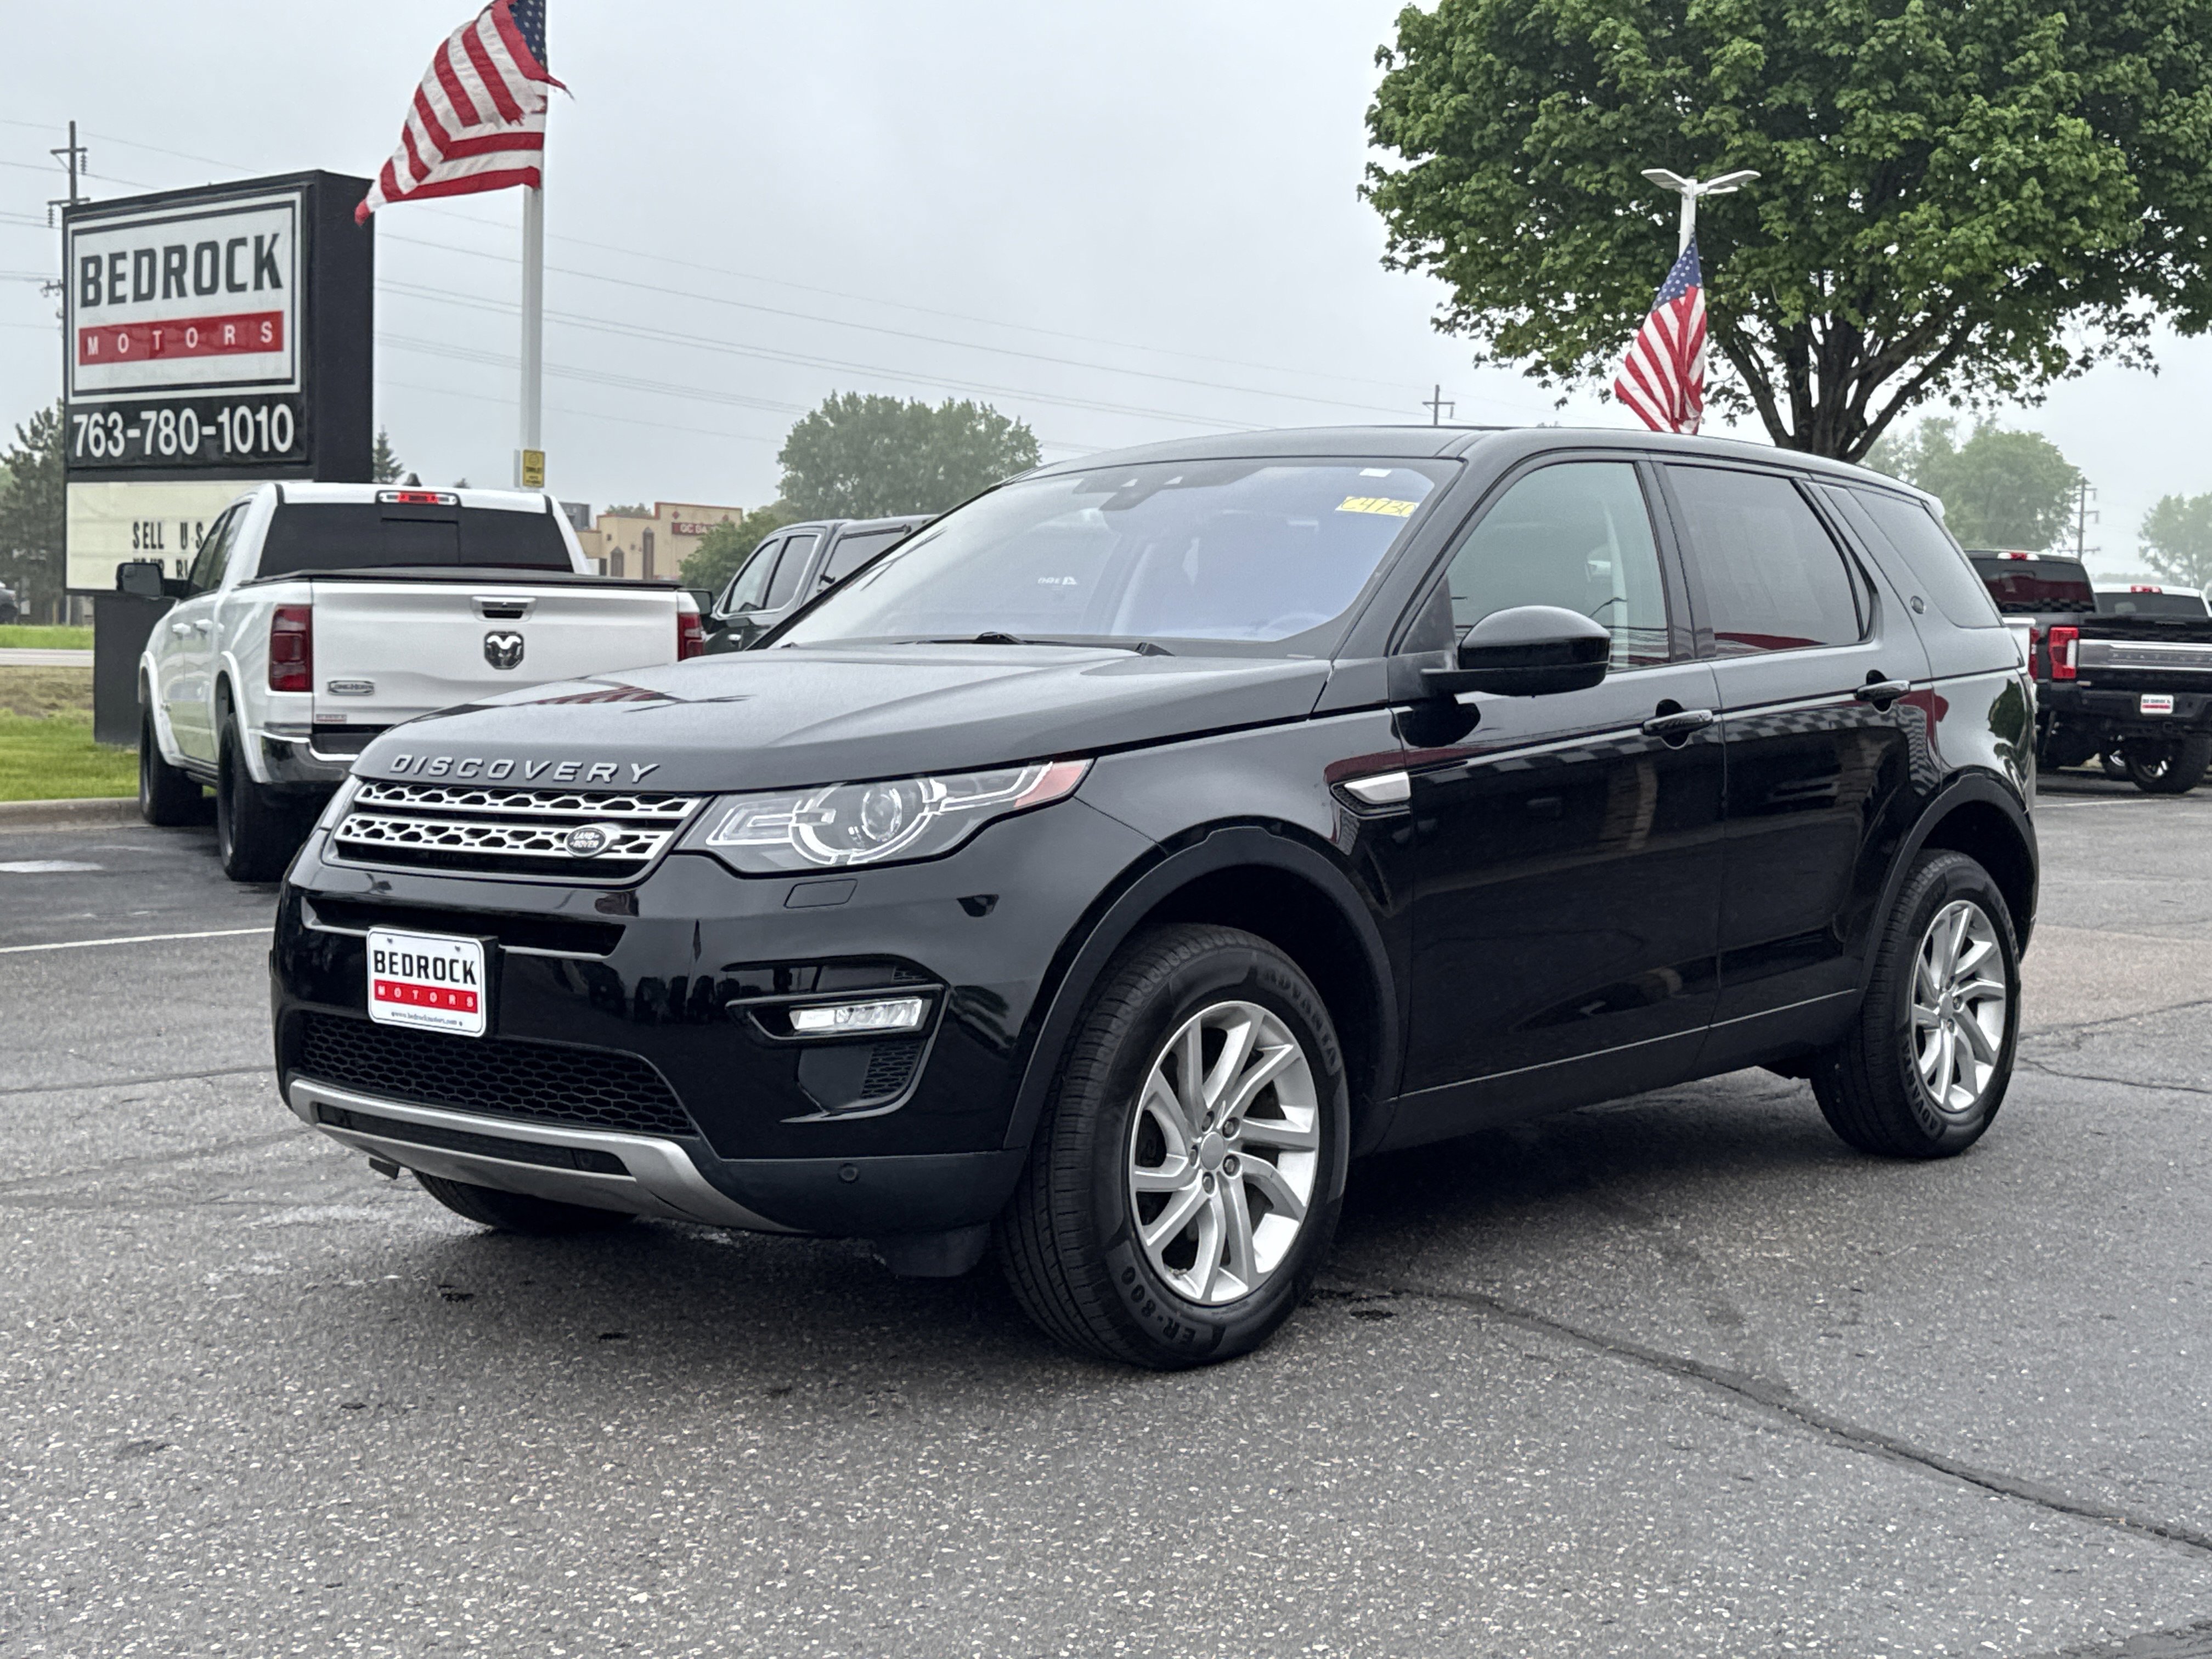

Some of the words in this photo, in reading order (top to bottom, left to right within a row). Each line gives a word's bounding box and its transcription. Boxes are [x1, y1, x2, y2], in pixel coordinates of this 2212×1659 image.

[80, 233, 283, 308] BEDROCK
[88, 321, 273, 357] MOTORS
[73, 403, 295, 458] 763-780-1010
[133, 522, 164, 549] SELL
[389, 754, 659, 783] DISCOVERY
[374, 950, 477, 985] BEDROCK
[377, 985, 474, 1008] MOTORS
